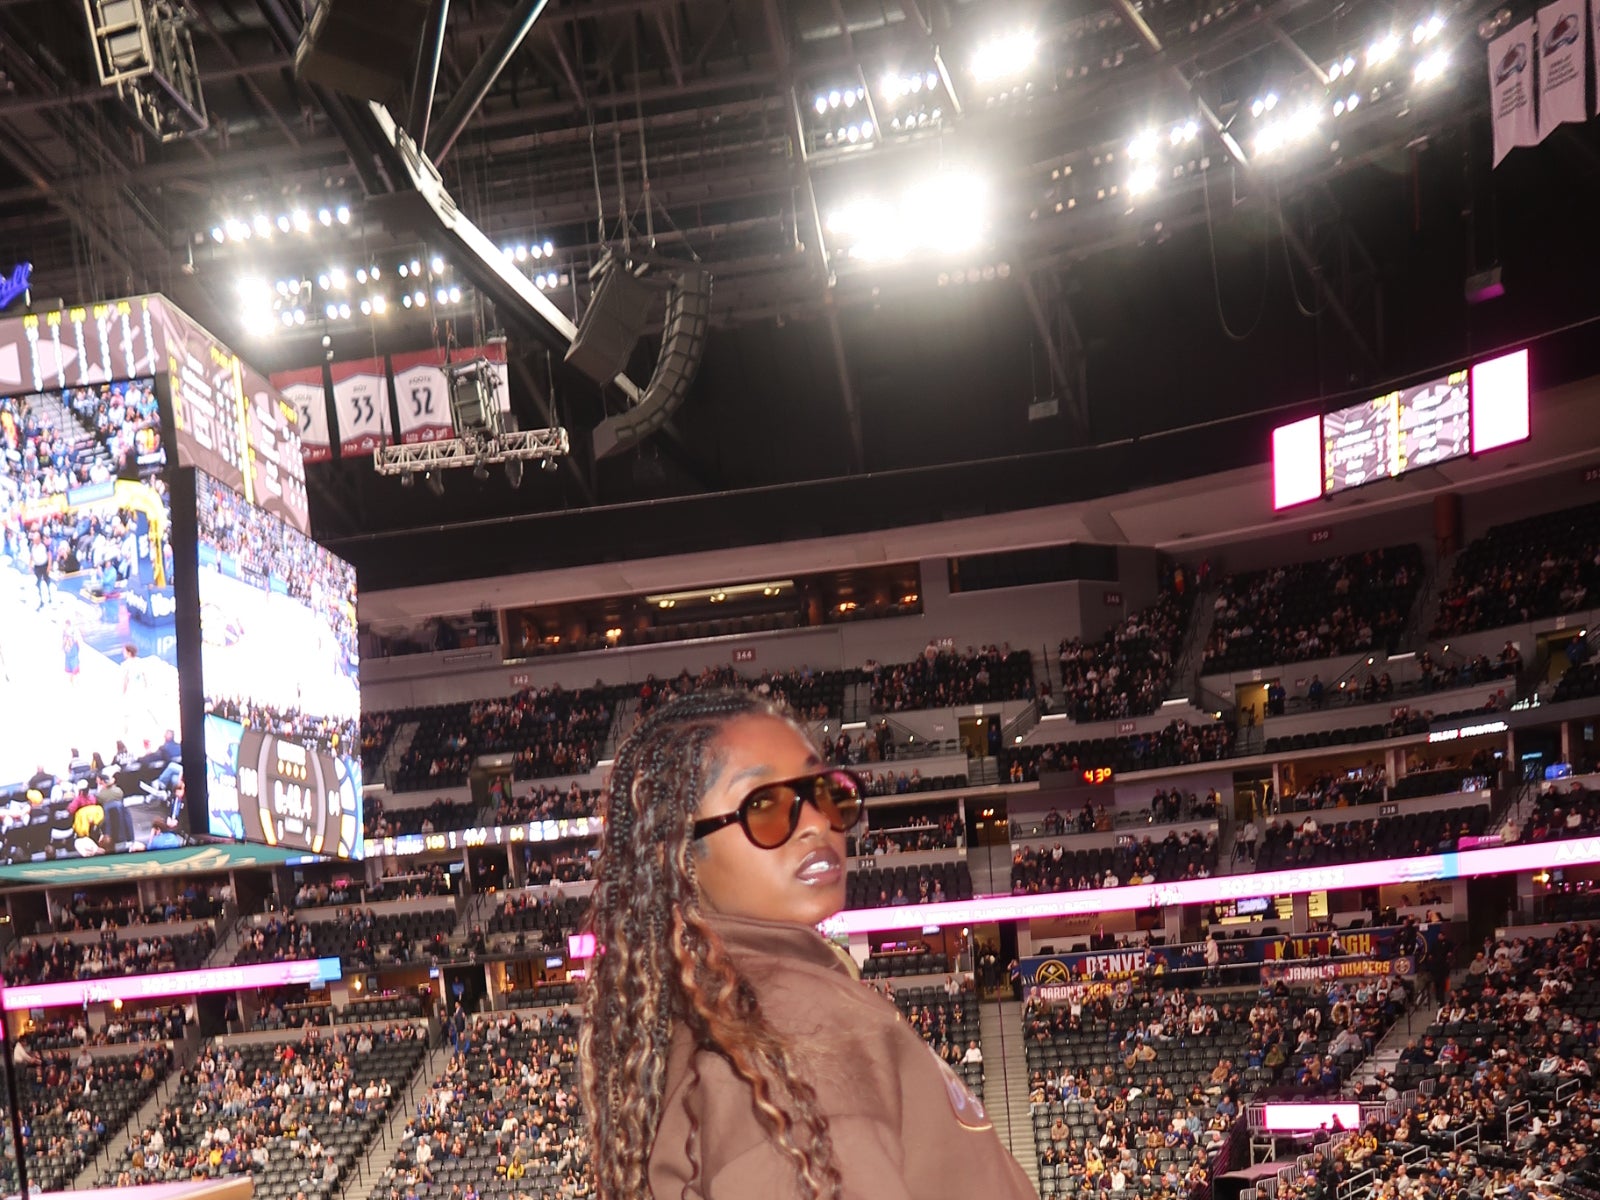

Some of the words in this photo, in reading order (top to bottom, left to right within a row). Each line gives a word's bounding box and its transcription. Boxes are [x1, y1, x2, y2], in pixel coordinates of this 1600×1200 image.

[351, 395, 375, 425] 33
[411, 387, 434, 417] 52
[737, 650, 752, 660] 344
[1086, 951, 1146, 976] DENVE
[1286, 965, 1335, 981] JAMAL'S
[1338, 960, 1391, 977] JUMPERS
[1040, 985, 1084, 1000] AARON'S
